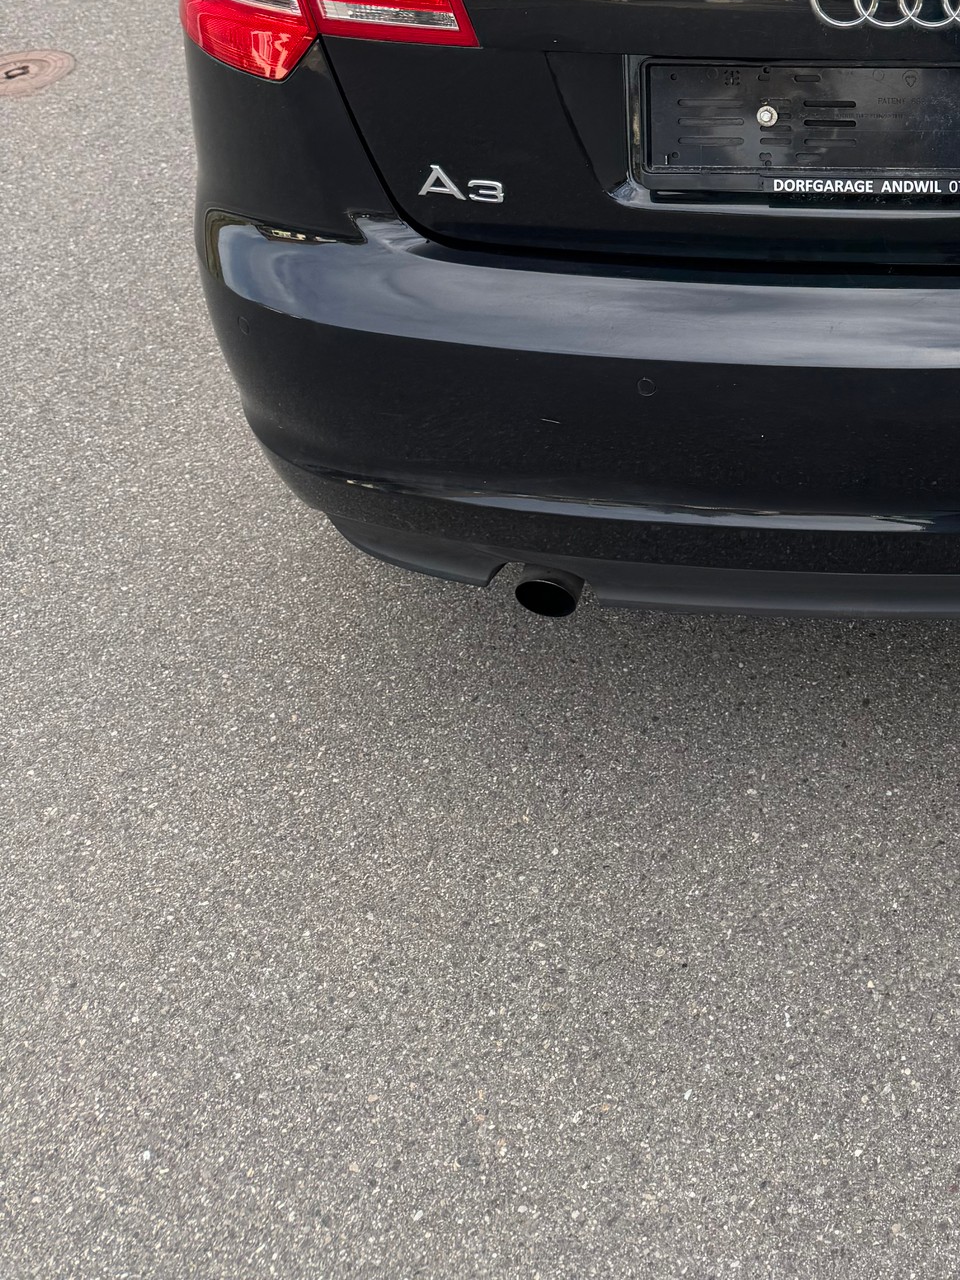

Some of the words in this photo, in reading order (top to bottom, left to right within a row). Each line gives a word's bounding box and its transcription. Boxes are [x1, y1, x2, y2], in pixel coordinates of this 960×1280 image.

[417, 164, 505, 204] A3
[773, 179, 874, 193] DORFGARAGE
[880, 180, 942, 194] ANDWIL
